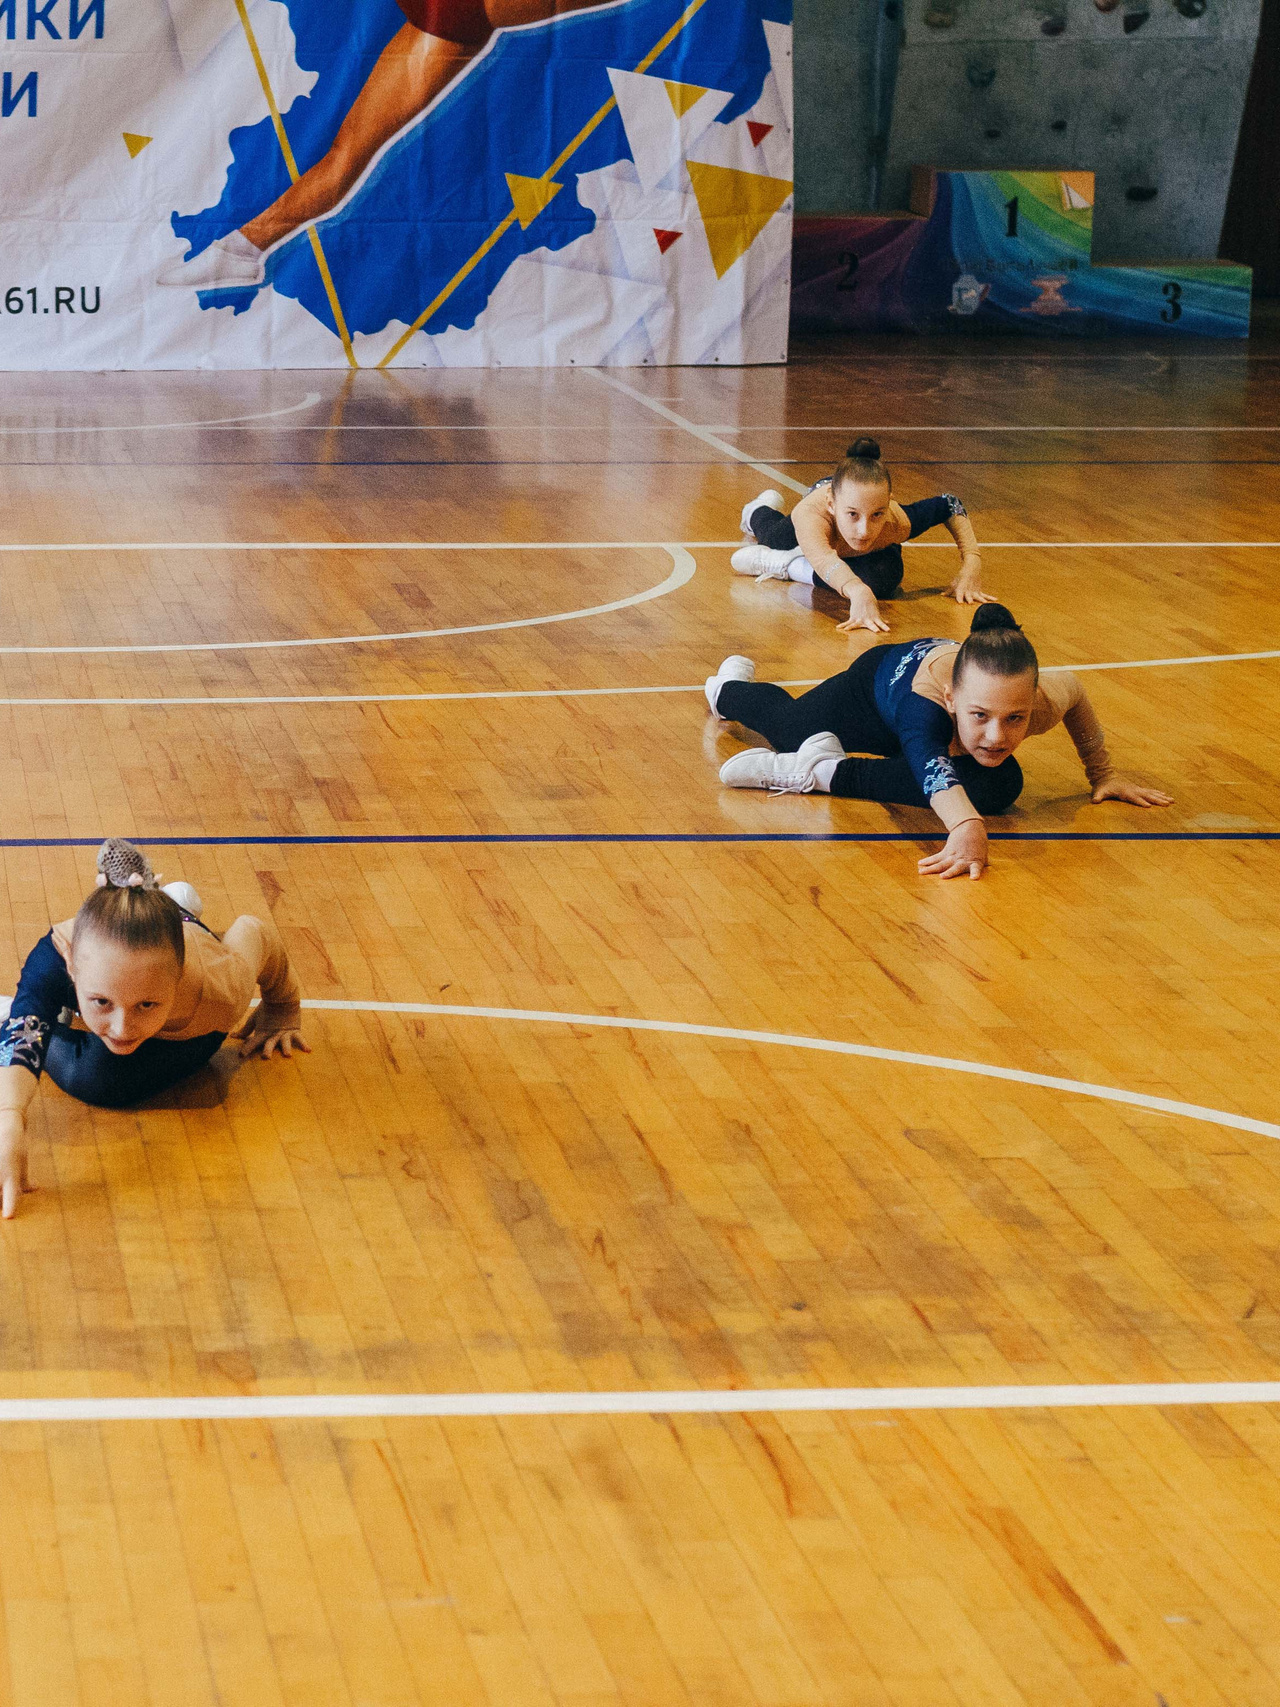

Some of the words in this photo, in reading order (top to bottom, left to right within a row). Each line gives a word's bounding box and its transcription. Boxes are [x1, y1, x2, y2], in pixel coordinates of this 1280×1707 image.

[1003, 196, 1019, 238] 1
[837, 252, 859, 291] 2
[1160, 282, 1182, 323] 3
